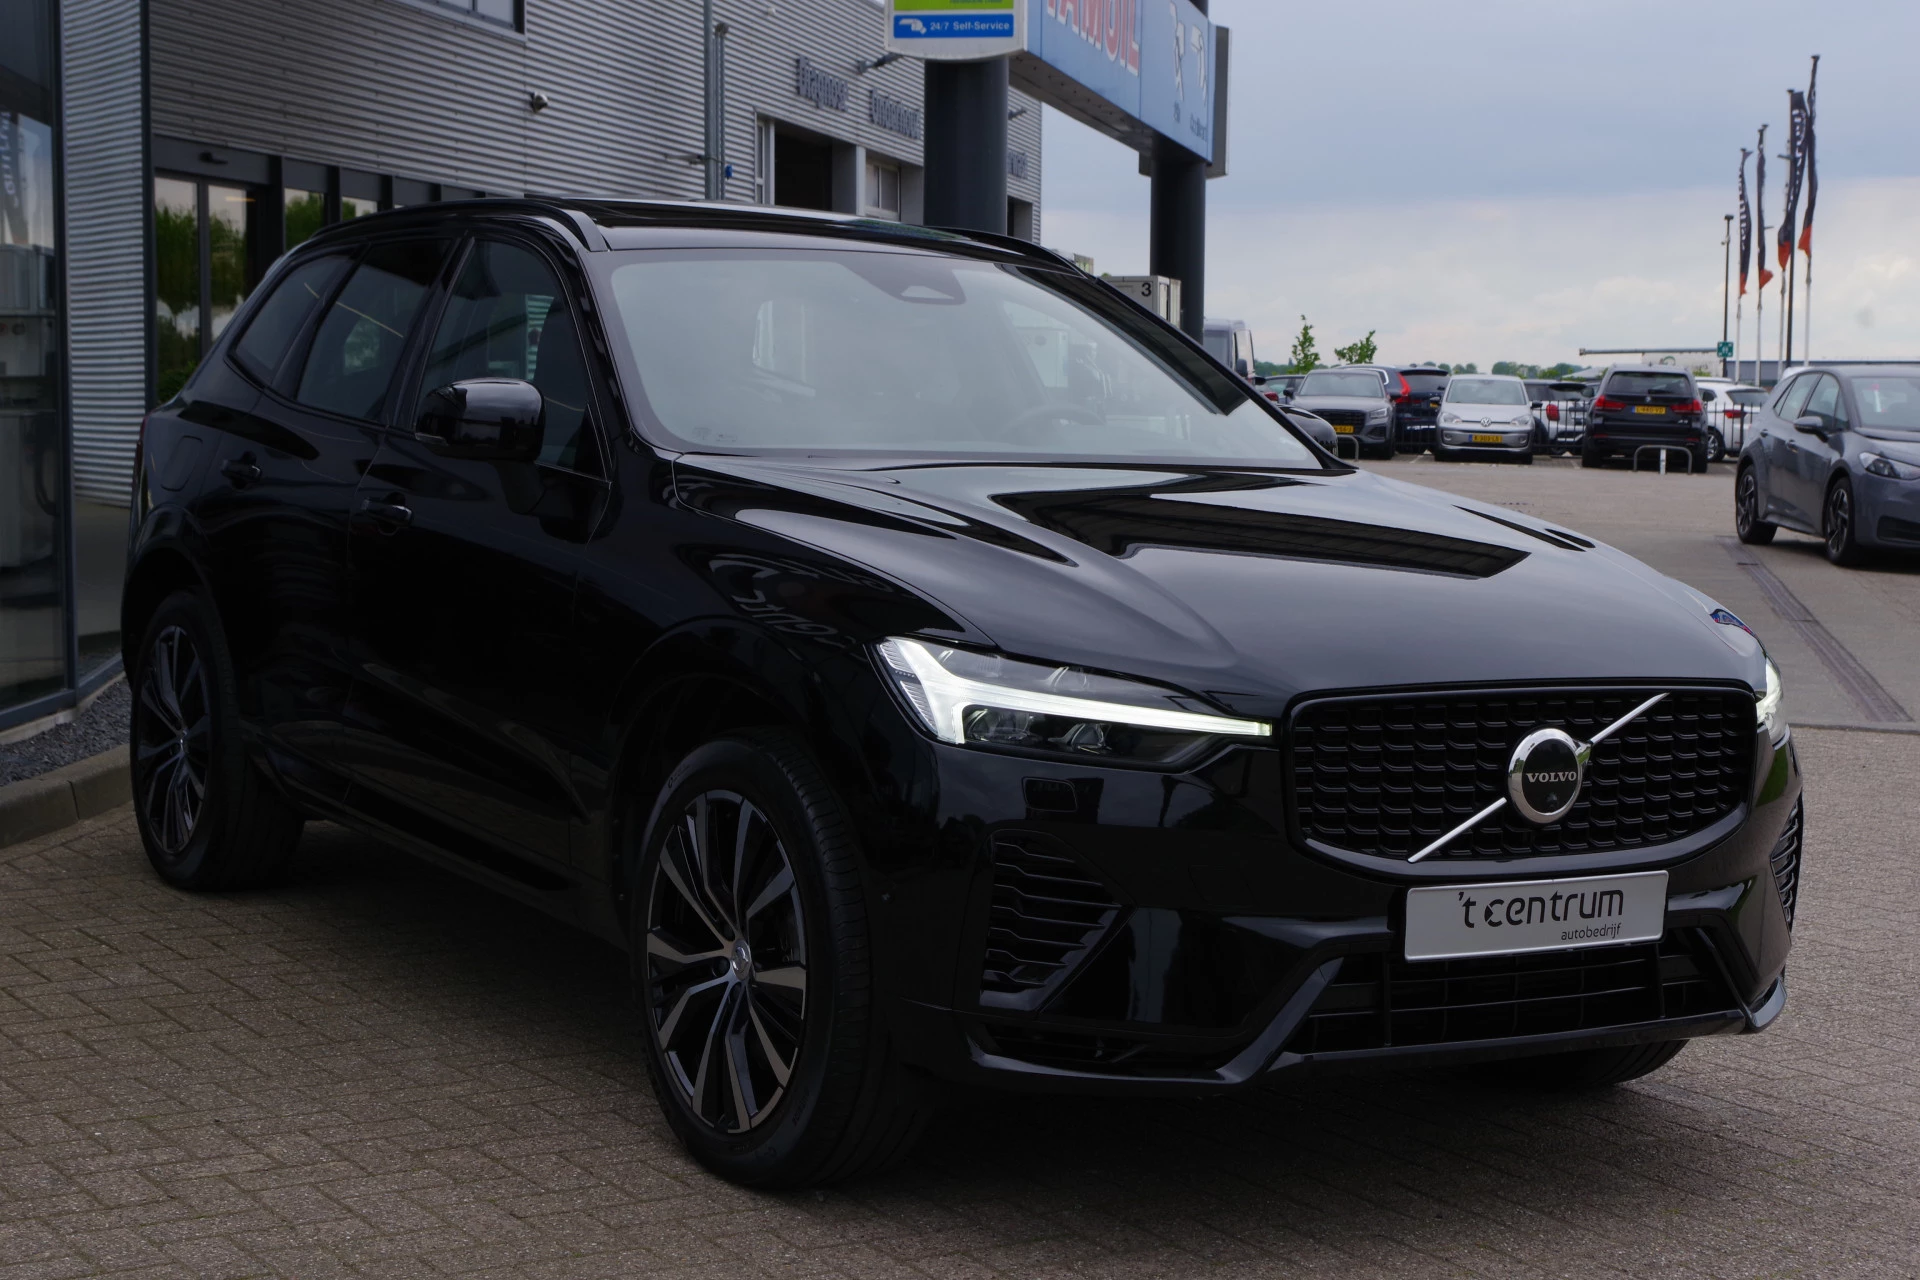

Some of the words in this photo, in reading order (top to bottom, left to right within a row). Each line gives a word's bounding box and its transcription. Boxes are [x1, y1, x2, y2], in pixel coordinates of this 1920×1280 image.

[930, 21, 950, 31] 24/7
[952, 20, 1010, 31] Self-Service
[1141, 282, 1152, 297] 3
[1526, 771, 1577, 783] VOLVO
[1484, 889, 1624, 928] centrum
[1561, 922, 1622, 941] autobedrijf
